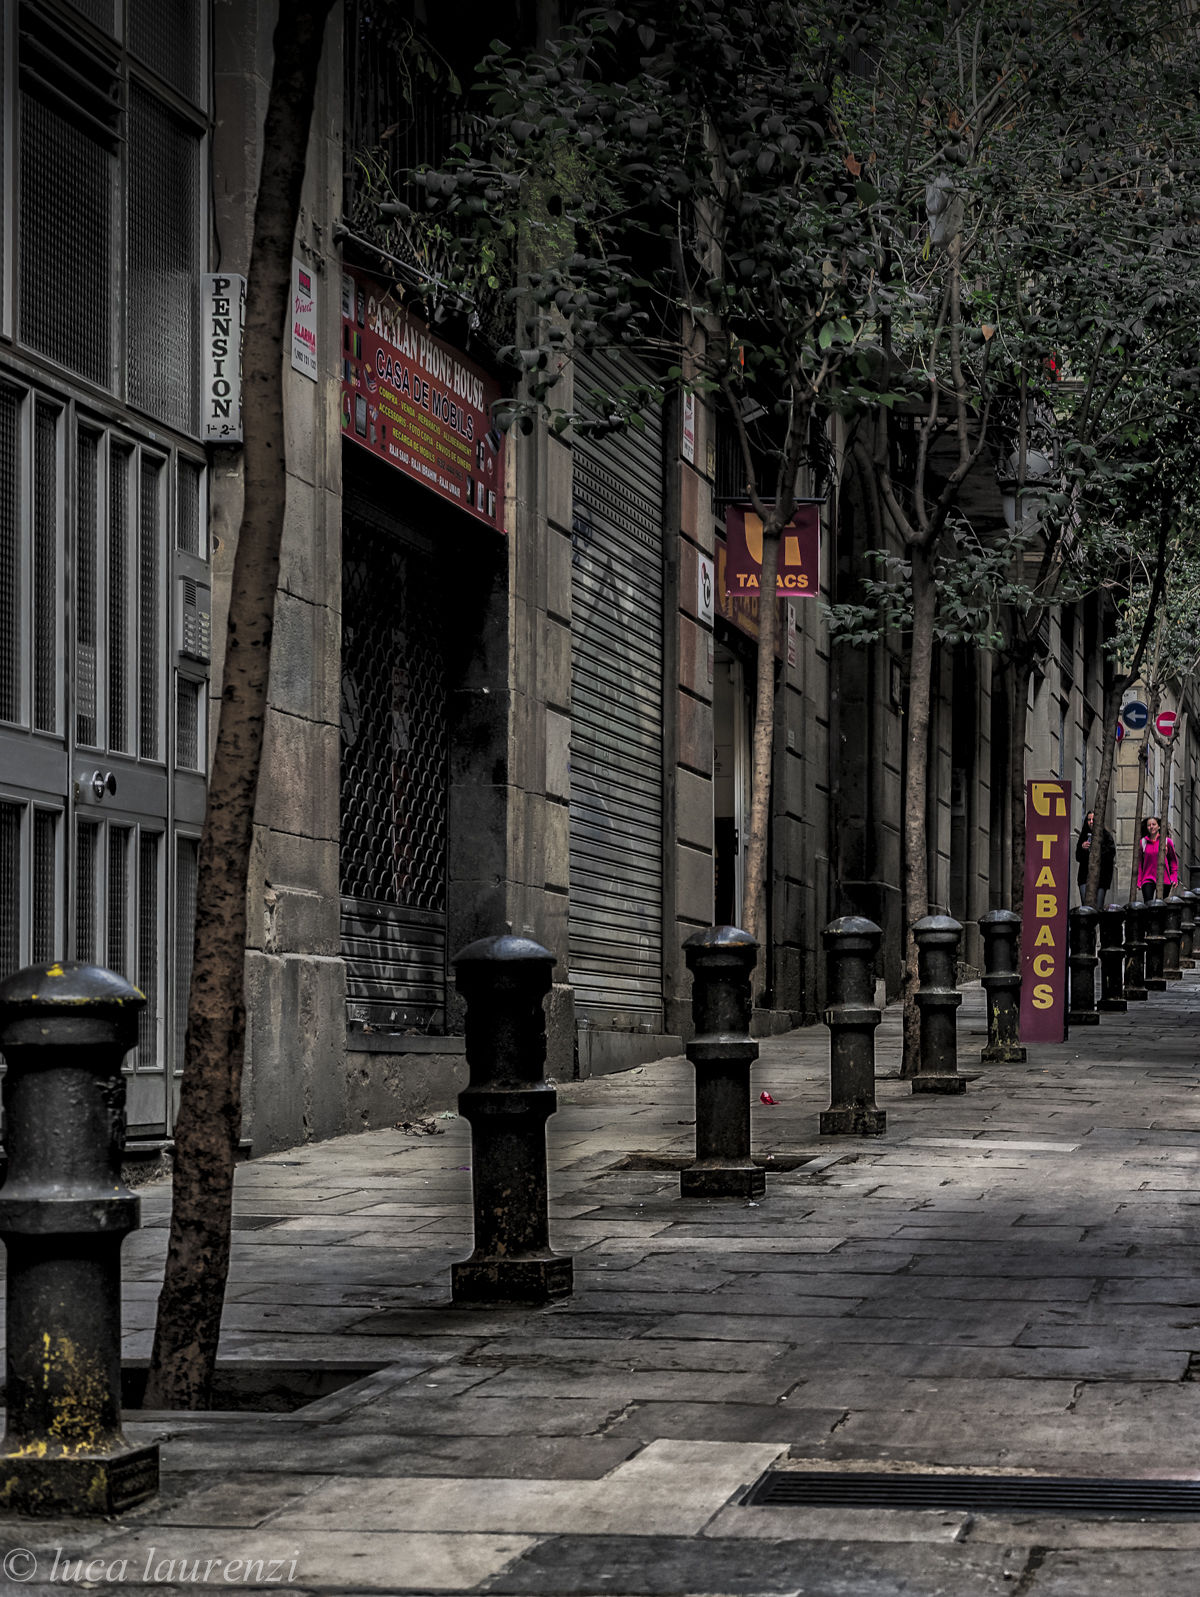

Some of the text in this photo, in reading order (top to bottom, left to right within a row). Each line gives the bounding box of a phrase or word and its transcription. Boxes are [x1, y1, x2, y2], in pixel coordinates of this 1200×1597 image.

[212, 278, 232, 418] PENSION
[376, 347, 474, 442] CASA DE MÓBILS
[419, 334, 452, 389] PHONE
[453, 360, 484, 413] HOUSE
[736, 573, 809, 589] TAACS
[1032, 834, 1058, 1010] TABACS
